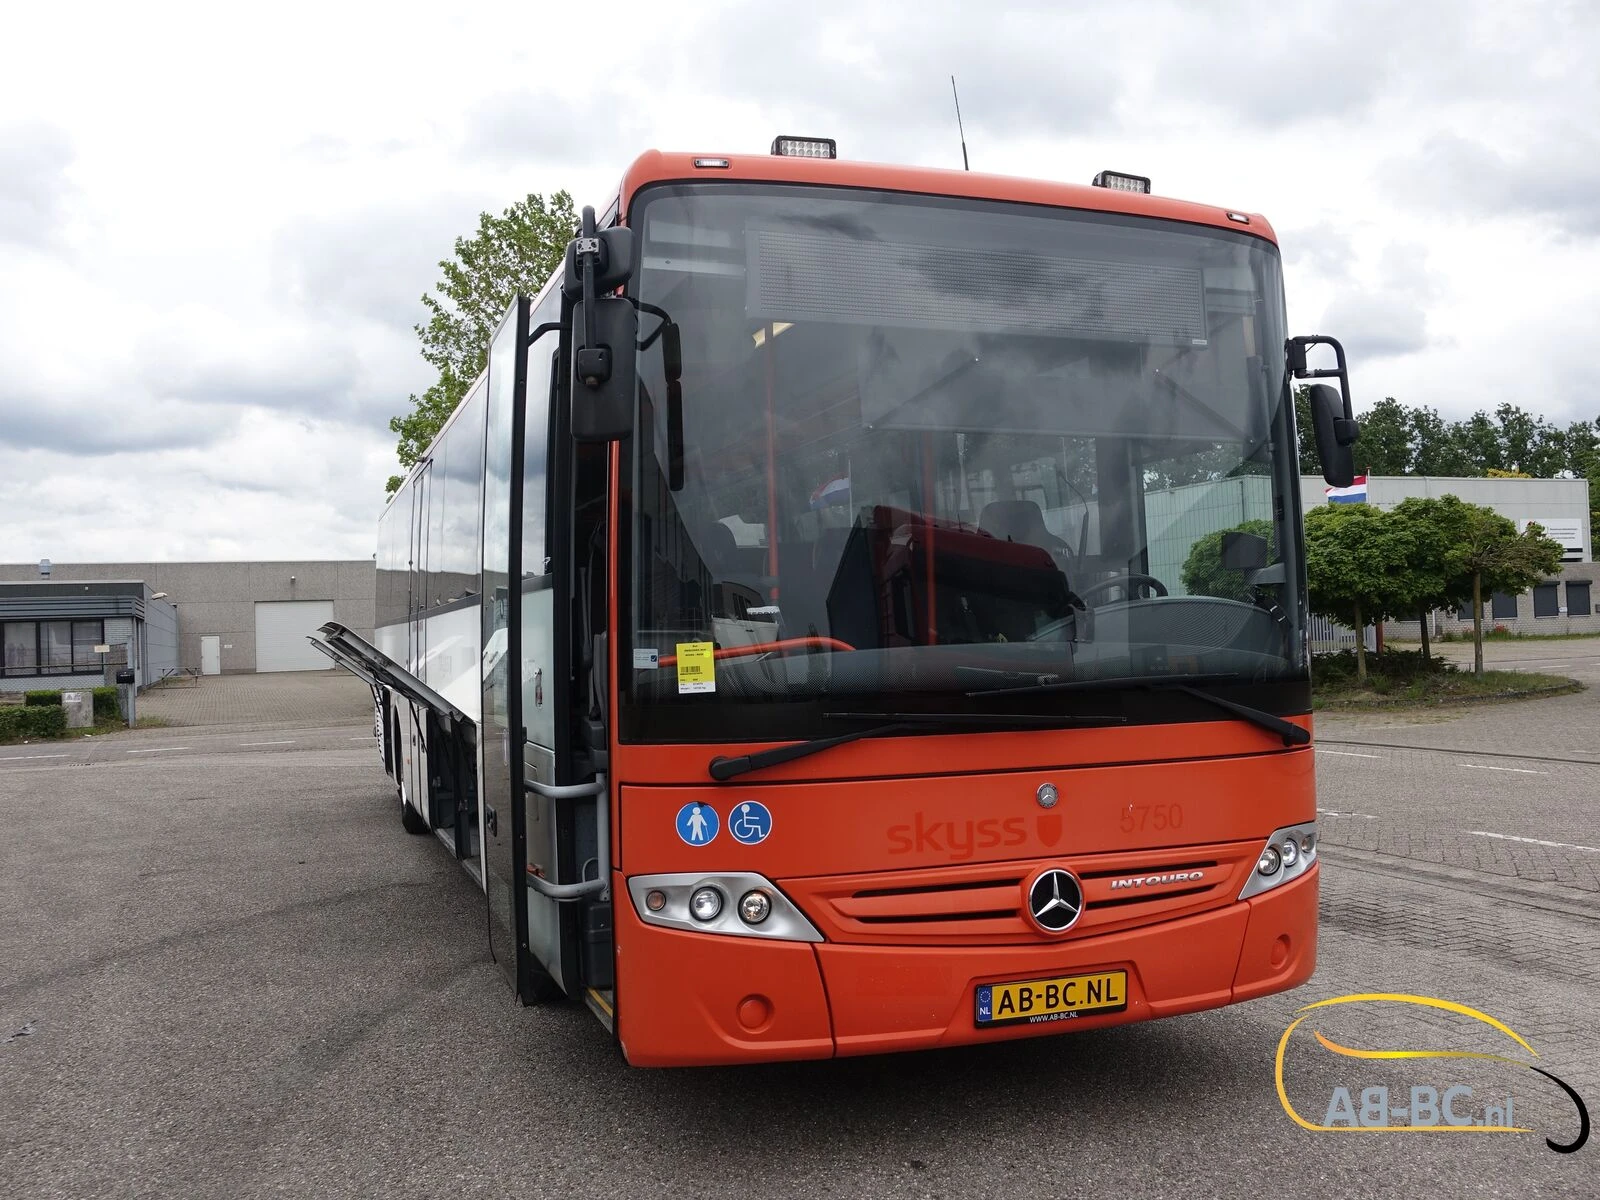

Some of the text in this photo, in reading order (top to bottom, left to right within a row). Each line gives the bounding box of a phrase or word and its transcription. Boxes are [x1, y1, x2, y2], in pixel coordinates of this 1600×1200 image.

[1119, 803, 1184, 834] 5750
[885, 811, 1027, 861] skyss
[1110, 871, 1204, 890] INTOURO
[997, 978, 1119, 1015] AB-BC.NL
[979, 1006, 991, 1016] NL
[1029, 1011, 1079, 1024] WWW.AB-BC.NL
